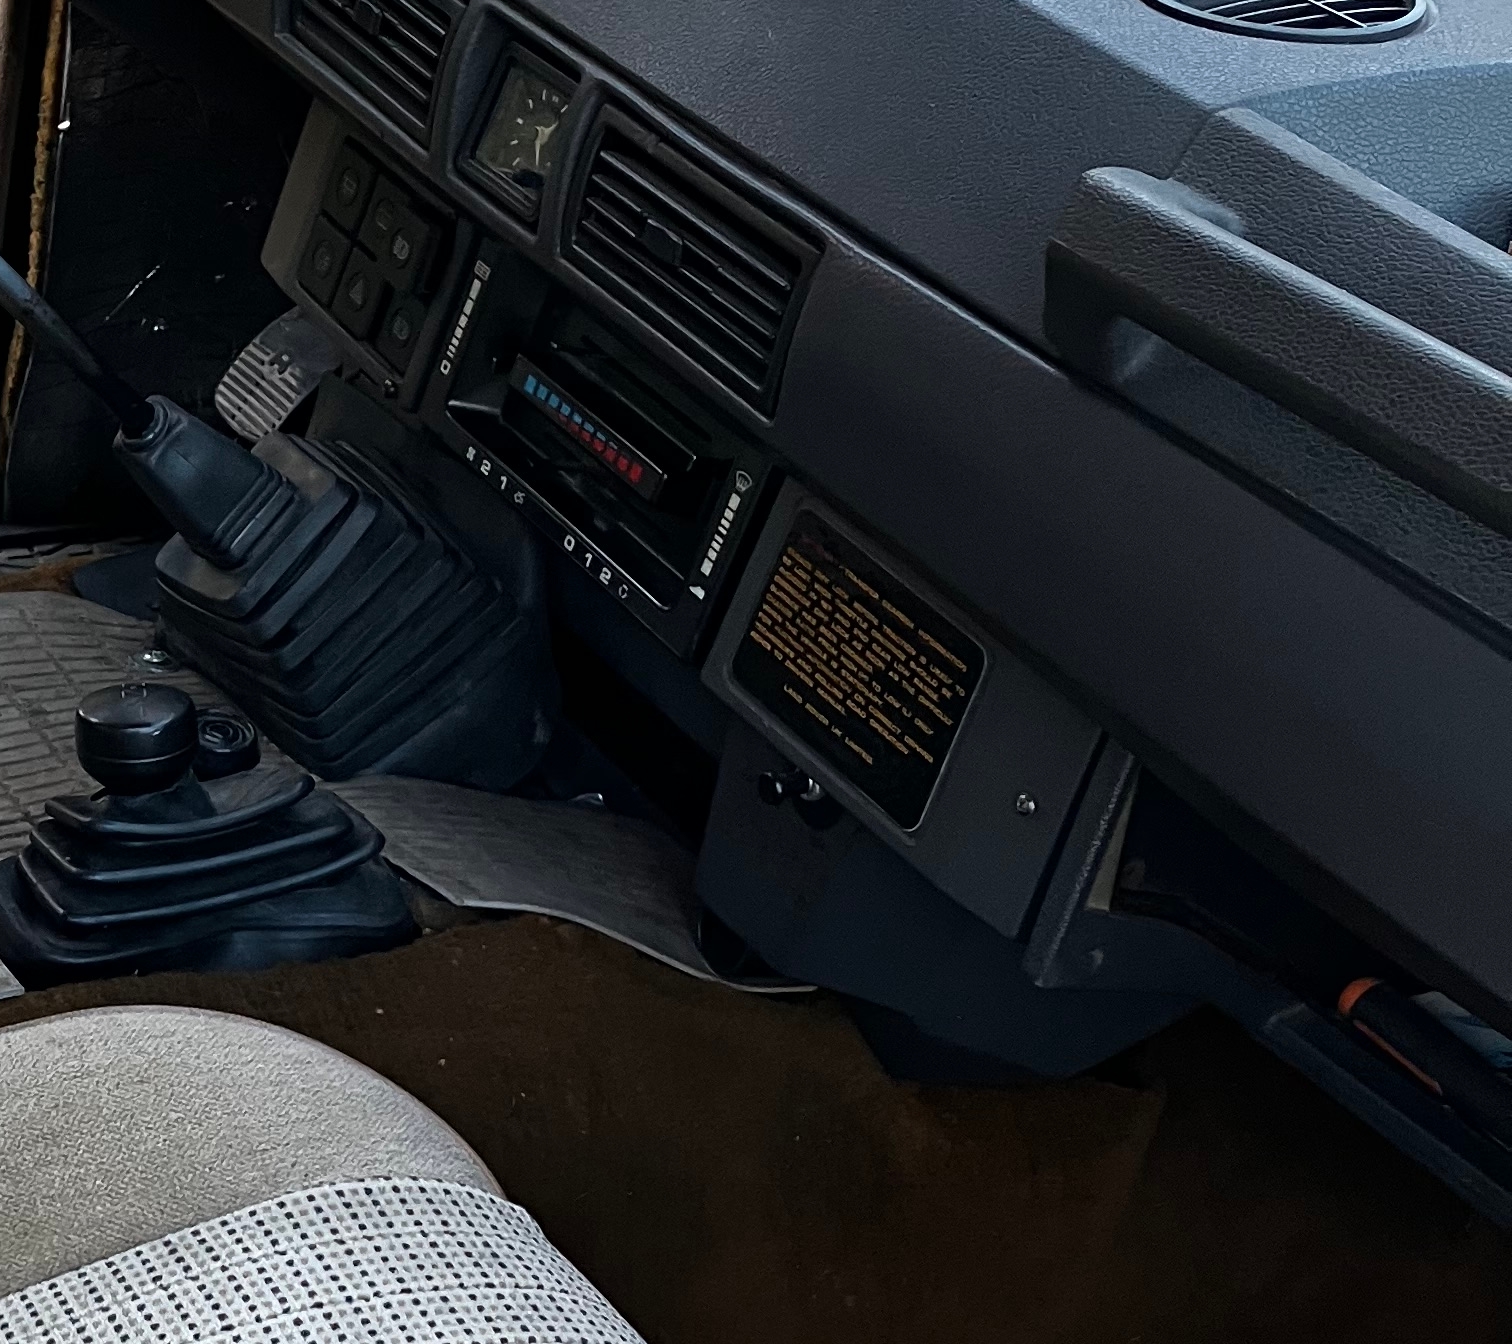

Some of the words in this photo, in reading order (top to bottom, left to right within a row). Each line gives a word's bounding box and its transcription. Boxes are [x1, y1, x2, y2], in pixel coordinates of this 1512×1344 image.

[480, 459, 492, 476] 2
[500, 475, 508, 490] 1
[584, 552, 593, 568] 1
[598, 567, 612, 585] 2
[893, 660, 911, 677] LOW
[871, 680, 882, 693] TO
[883, 692, 902, 709] LOW
[955, 684, 966, 697] TO
